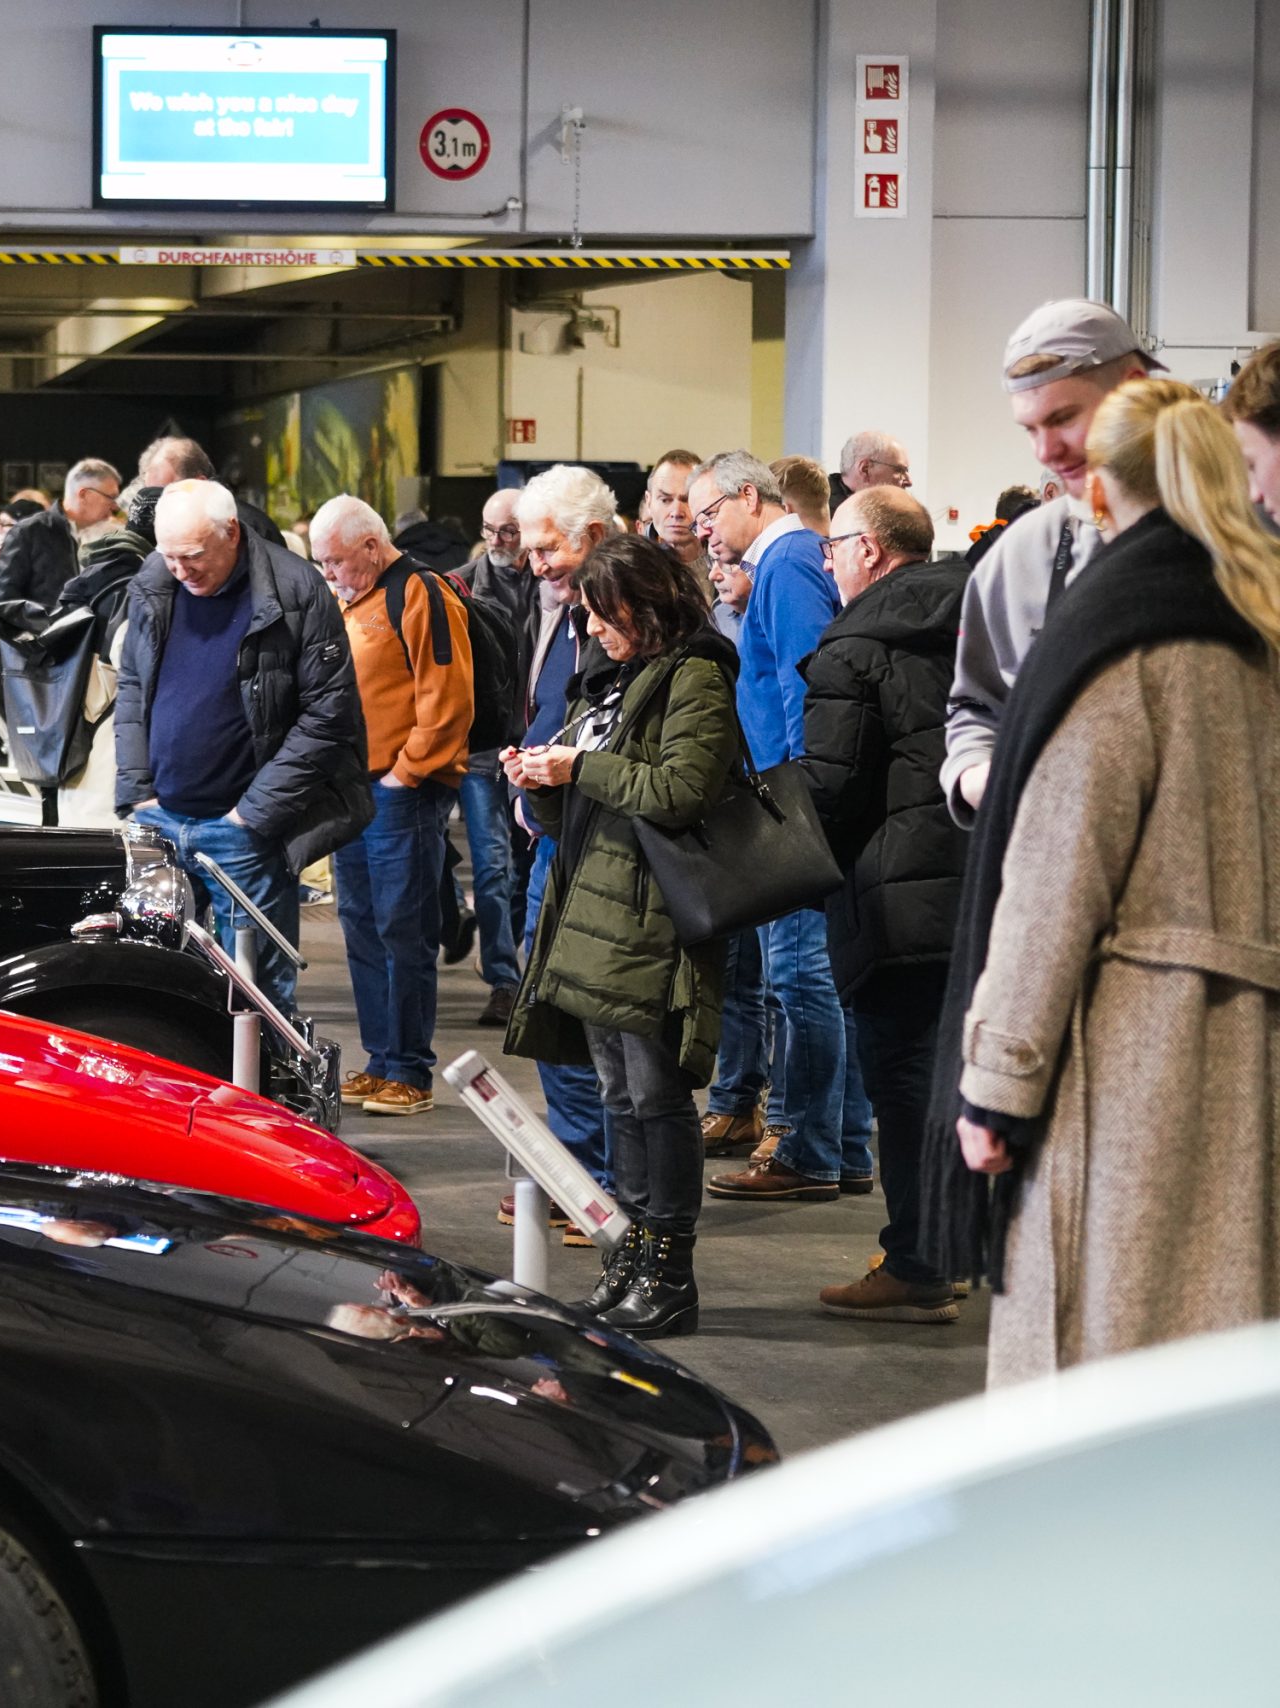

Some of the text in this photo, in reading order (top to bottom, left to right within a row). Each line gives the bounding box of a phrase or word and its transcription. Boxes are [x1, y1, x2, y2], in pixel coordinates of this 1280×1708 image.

[129, 91, 359, 118] We wish you a nice day
[193, 117, 216, 137] at
[216, 117, 252, 137] the
[158, 250, 317, 265] DURCHFAHRTSHÖHE
